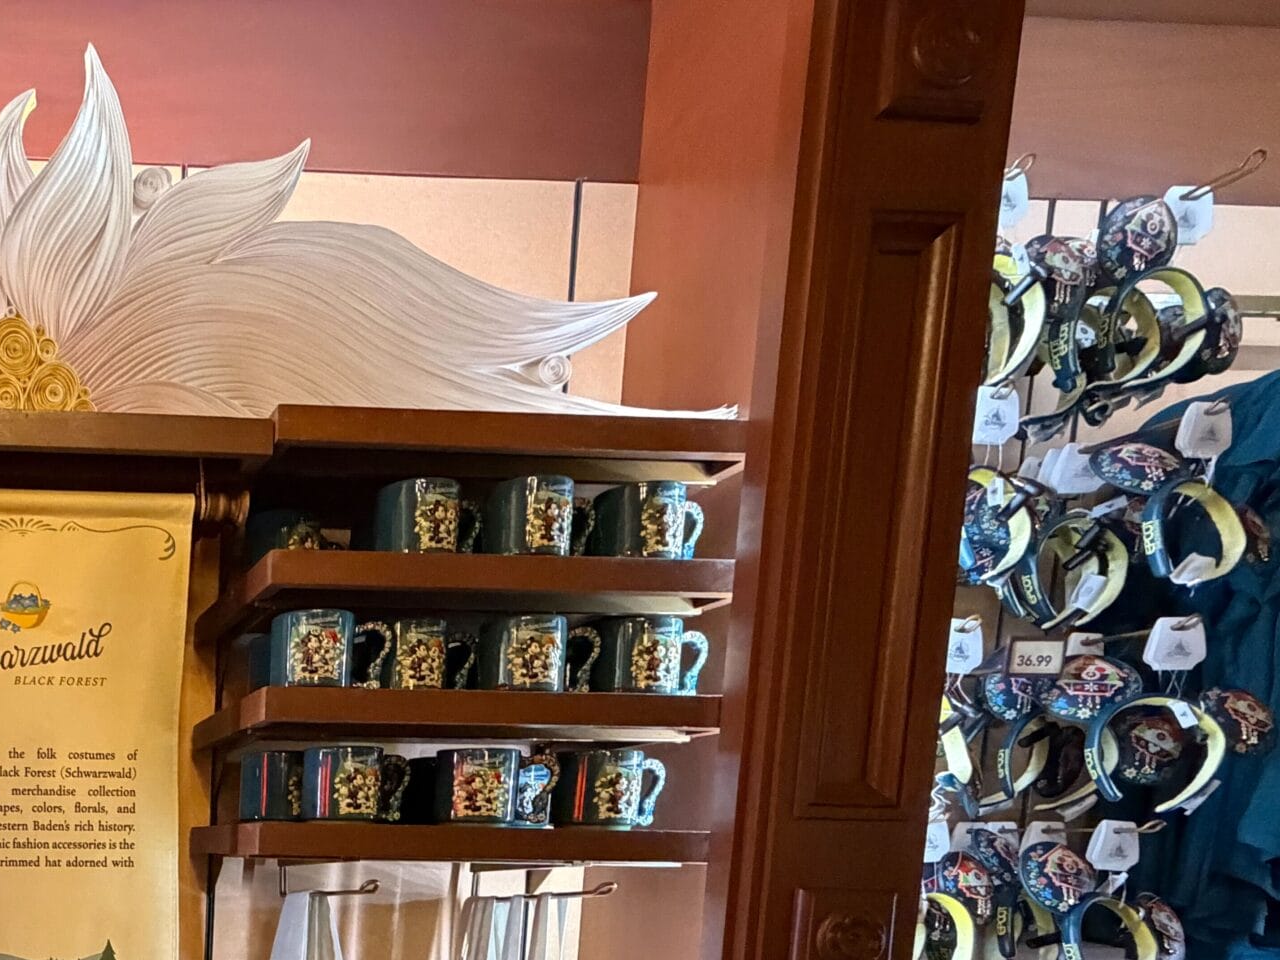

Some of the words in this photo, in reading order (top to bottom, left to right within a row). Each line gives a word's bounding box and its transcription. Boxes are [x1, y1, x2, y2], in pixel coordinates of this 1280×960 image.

[1059, 322, 1069, 356] EPCOT
[1142, 520, 1156, 555] EPCOT
[1022, 575, 1037, 605] EPCOT
[1017, 655, 1052, 667] 36.99
[14, 676, 54, 686] BLACK
[59, 677, 107, 686] FOREST
[9, 748, 25, 758] the
[37, 748, 56, 759] folk
[68, 749, 115, 760] costumes
[127, 749, 138, 761] of
[996, 749, 1006, 779] EPCOT
[1084, 748, 1098, 780] EPCOT
[24, 767, 56, 778] Forest
[60, 767, 137, 780] (Schwarzwald)
[11, 786, 76, 796] merchandise
[88, 786, 136, 797] collection
[32, 802, 65, 814] colors,
[74, 802, 108, 814] florals,
[117, 803, 136, 814] and
[33, 821, 70, 831] Baden's
[74, 821, 94, 831] rich
[98, 821, 135, 834] history.
[12, 838, 49, 849] fashion
[51, 840, 106, 849] accessories
[109, 840, 117, 849] is
[119, 839, 135, 849] the
[45, 857, 61, 867] hat
[66, 857, 107, 867] adorned
[112, 857, 134, 868] with
[997, 906, 1008, 936] EPCOT
